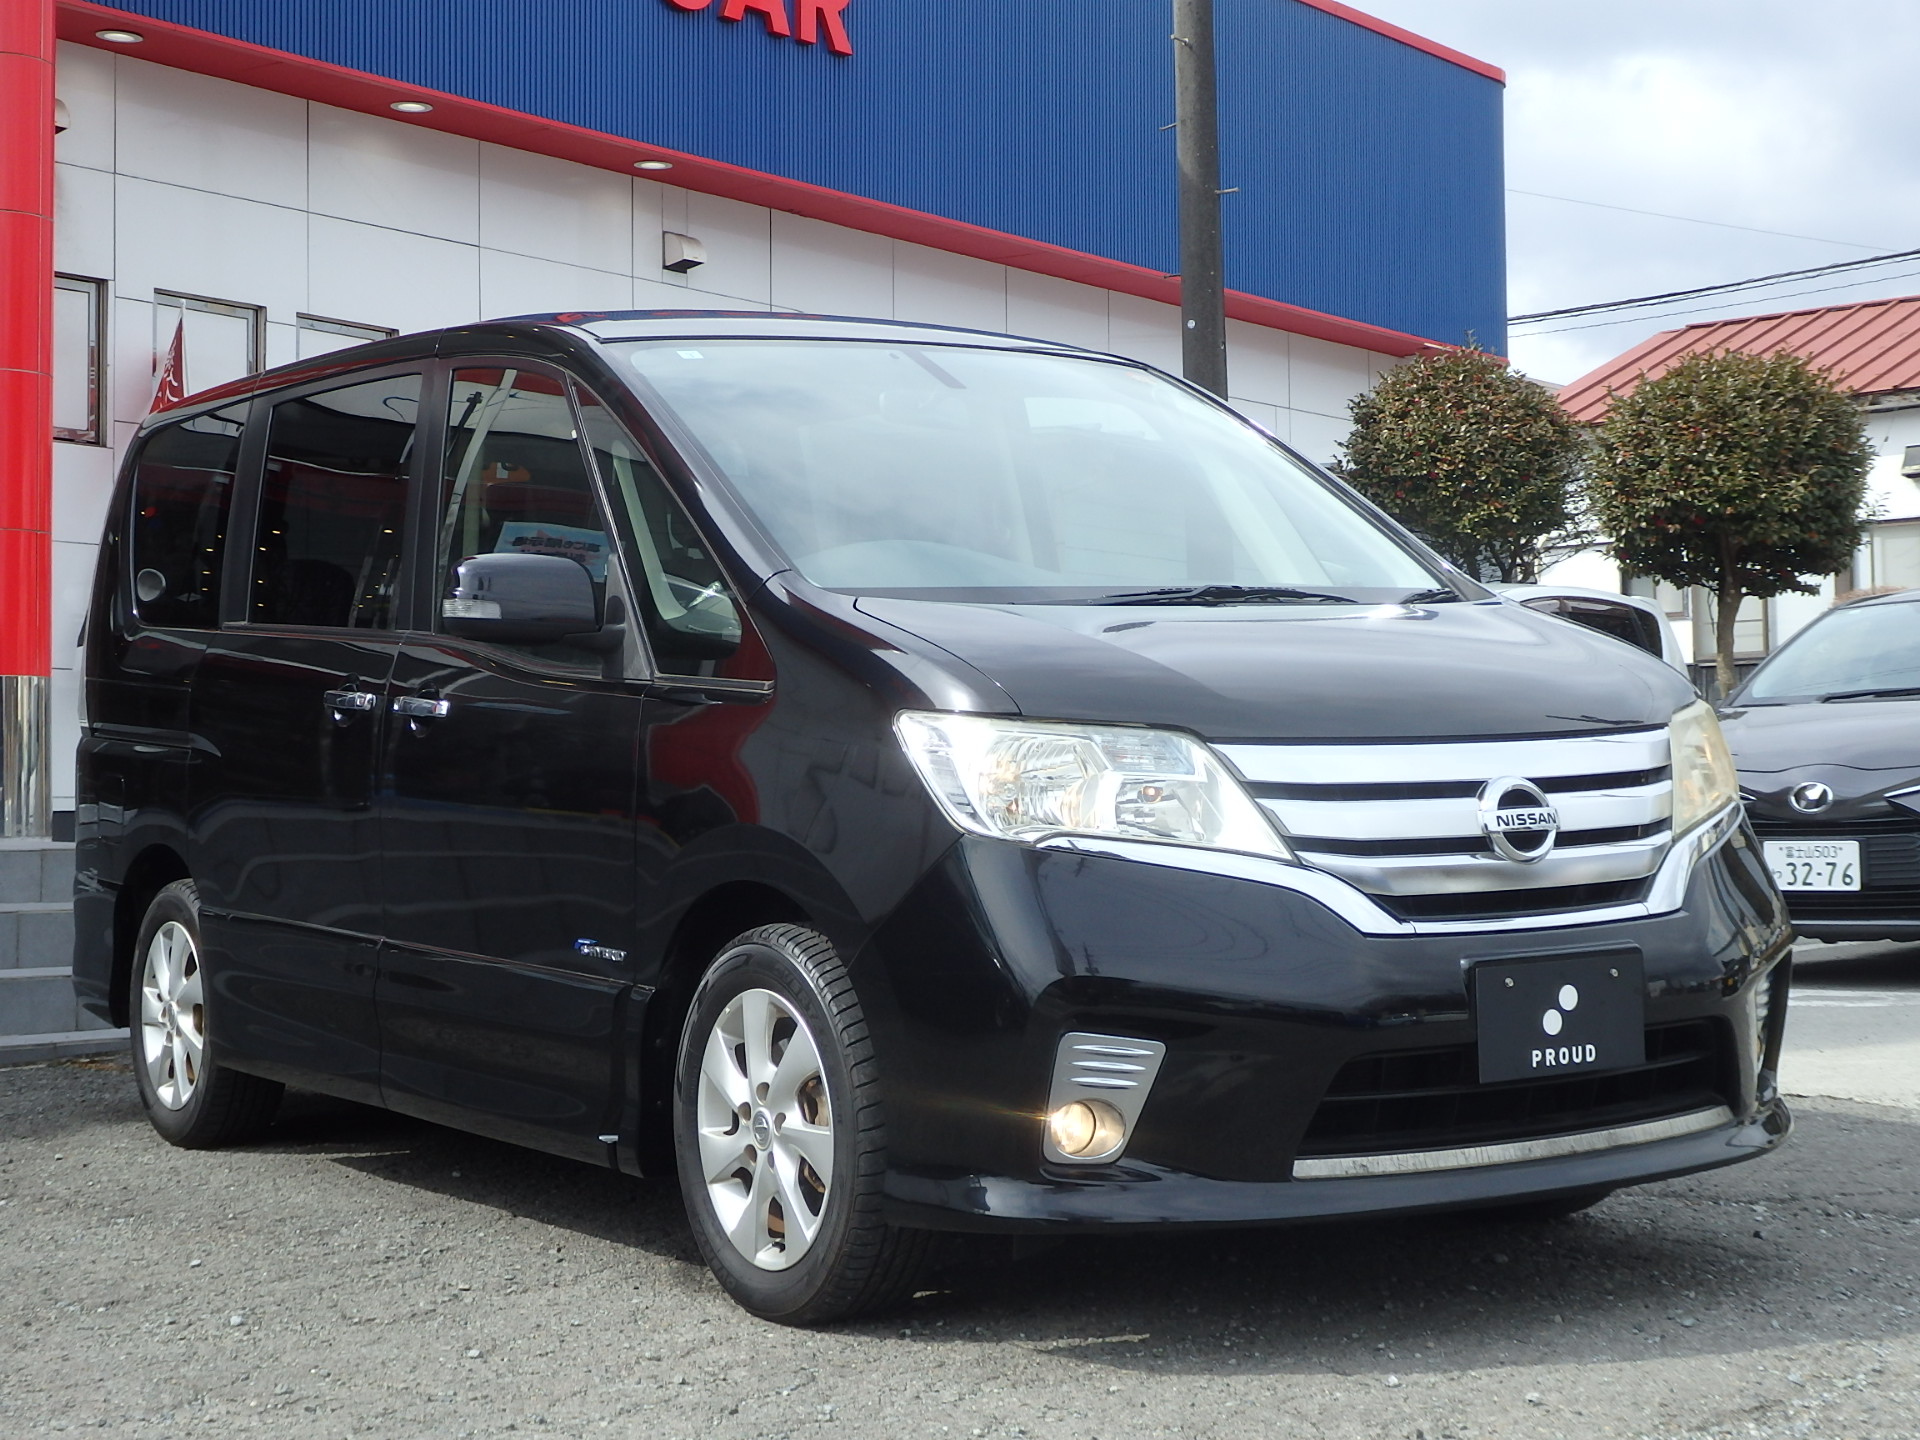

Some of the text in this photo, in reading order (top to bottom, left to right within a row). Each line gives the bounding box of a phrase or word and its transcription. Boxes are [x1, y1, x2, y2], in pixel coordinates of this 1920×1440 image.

[1496, 812, 1557, 827] NISSAN
[1786, 862, 1853, 886] 32-76
[1531, 1044, 1596, 1068] PROUD
